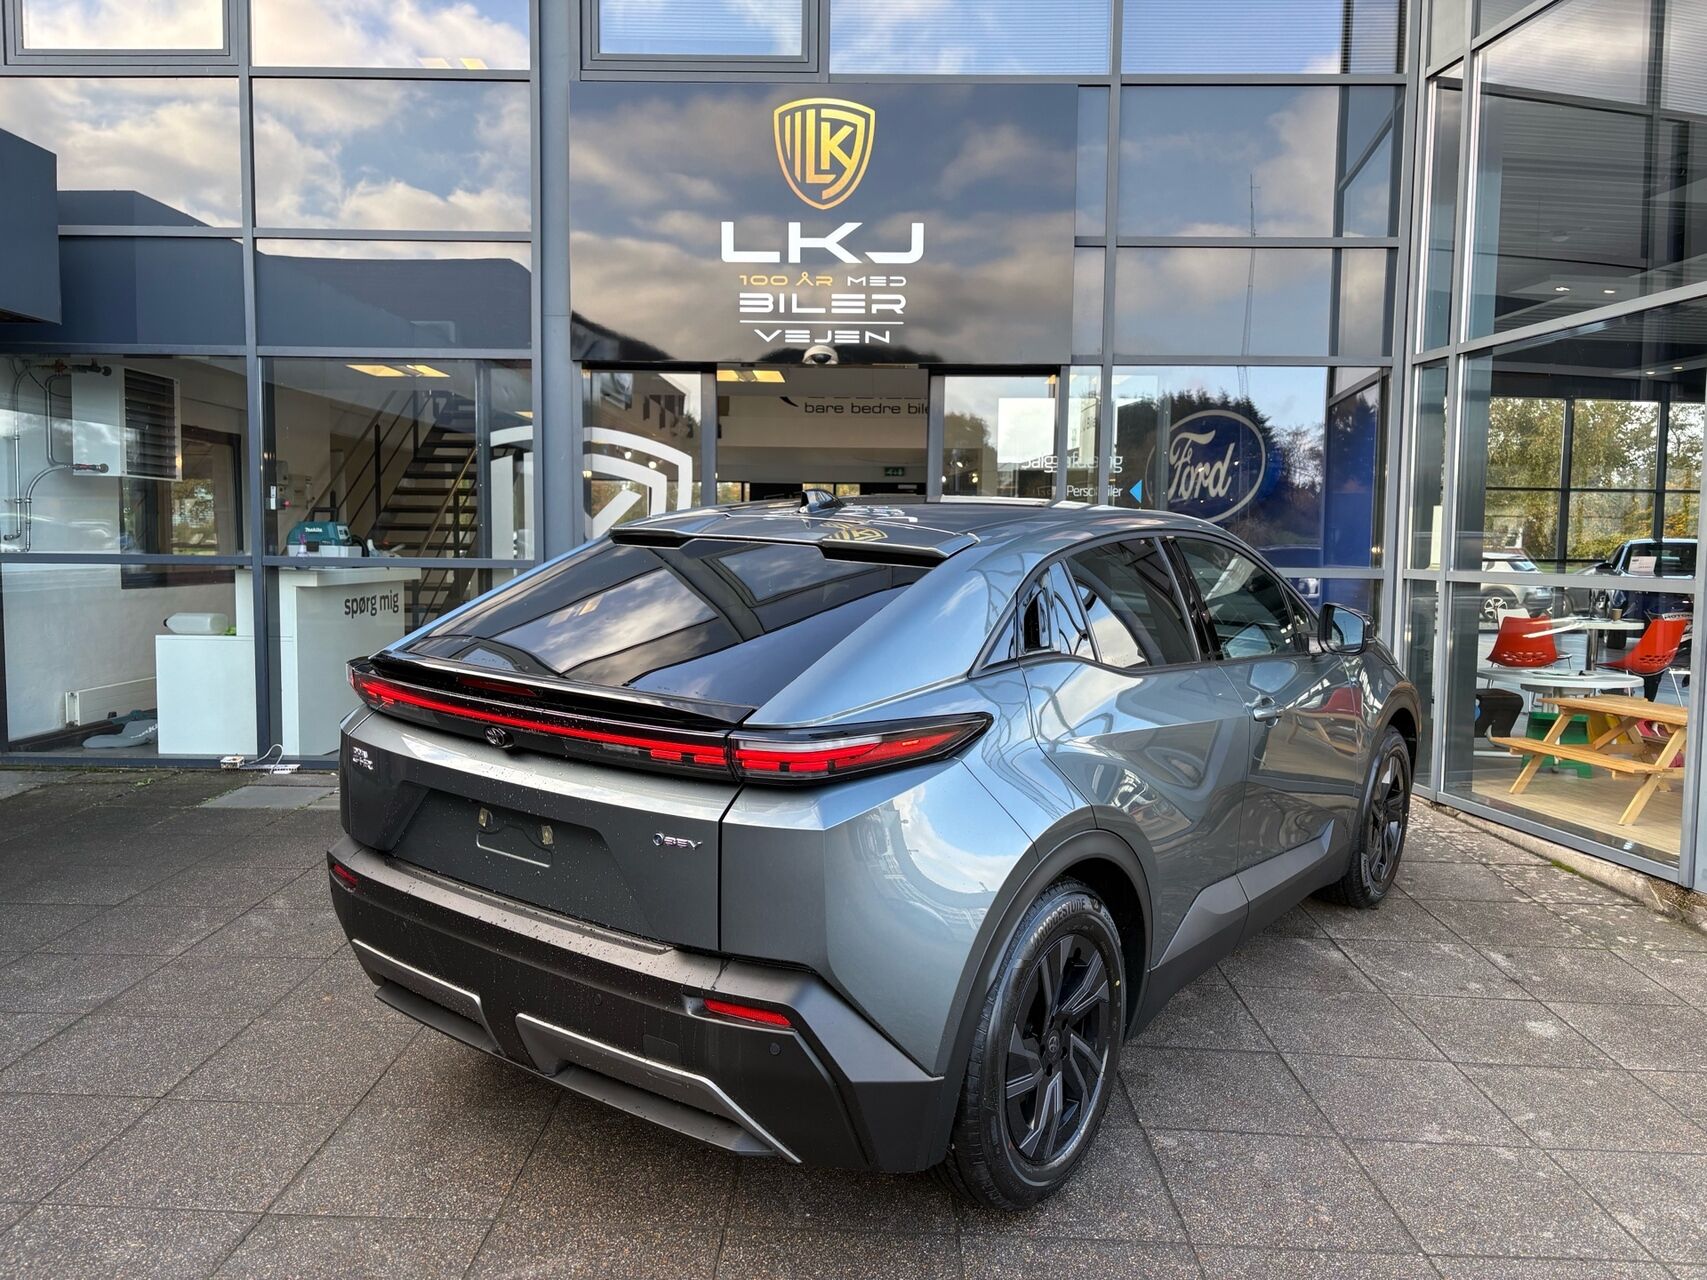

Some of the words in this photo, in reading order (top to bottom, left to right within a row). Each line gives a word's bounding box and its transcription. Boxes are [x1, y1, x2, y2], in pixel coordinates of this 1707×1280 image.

[721, 221, 925, 264] LKJ
[739, 274, 788, 287] 100
[795, 271, 833, 287] ÅR
[847, 275, 907, 287] MED
[739, 292, 907, 314] BILER
[754, 328, 890, 344] VEJEN
[804, 402, 844, 413] bare
[850, 402, 901, 414] bedre
[1168, 428, 1236, 501] Ford
[344, 594, 378, 619] spørg
[380, 589, 400, 614] mig
